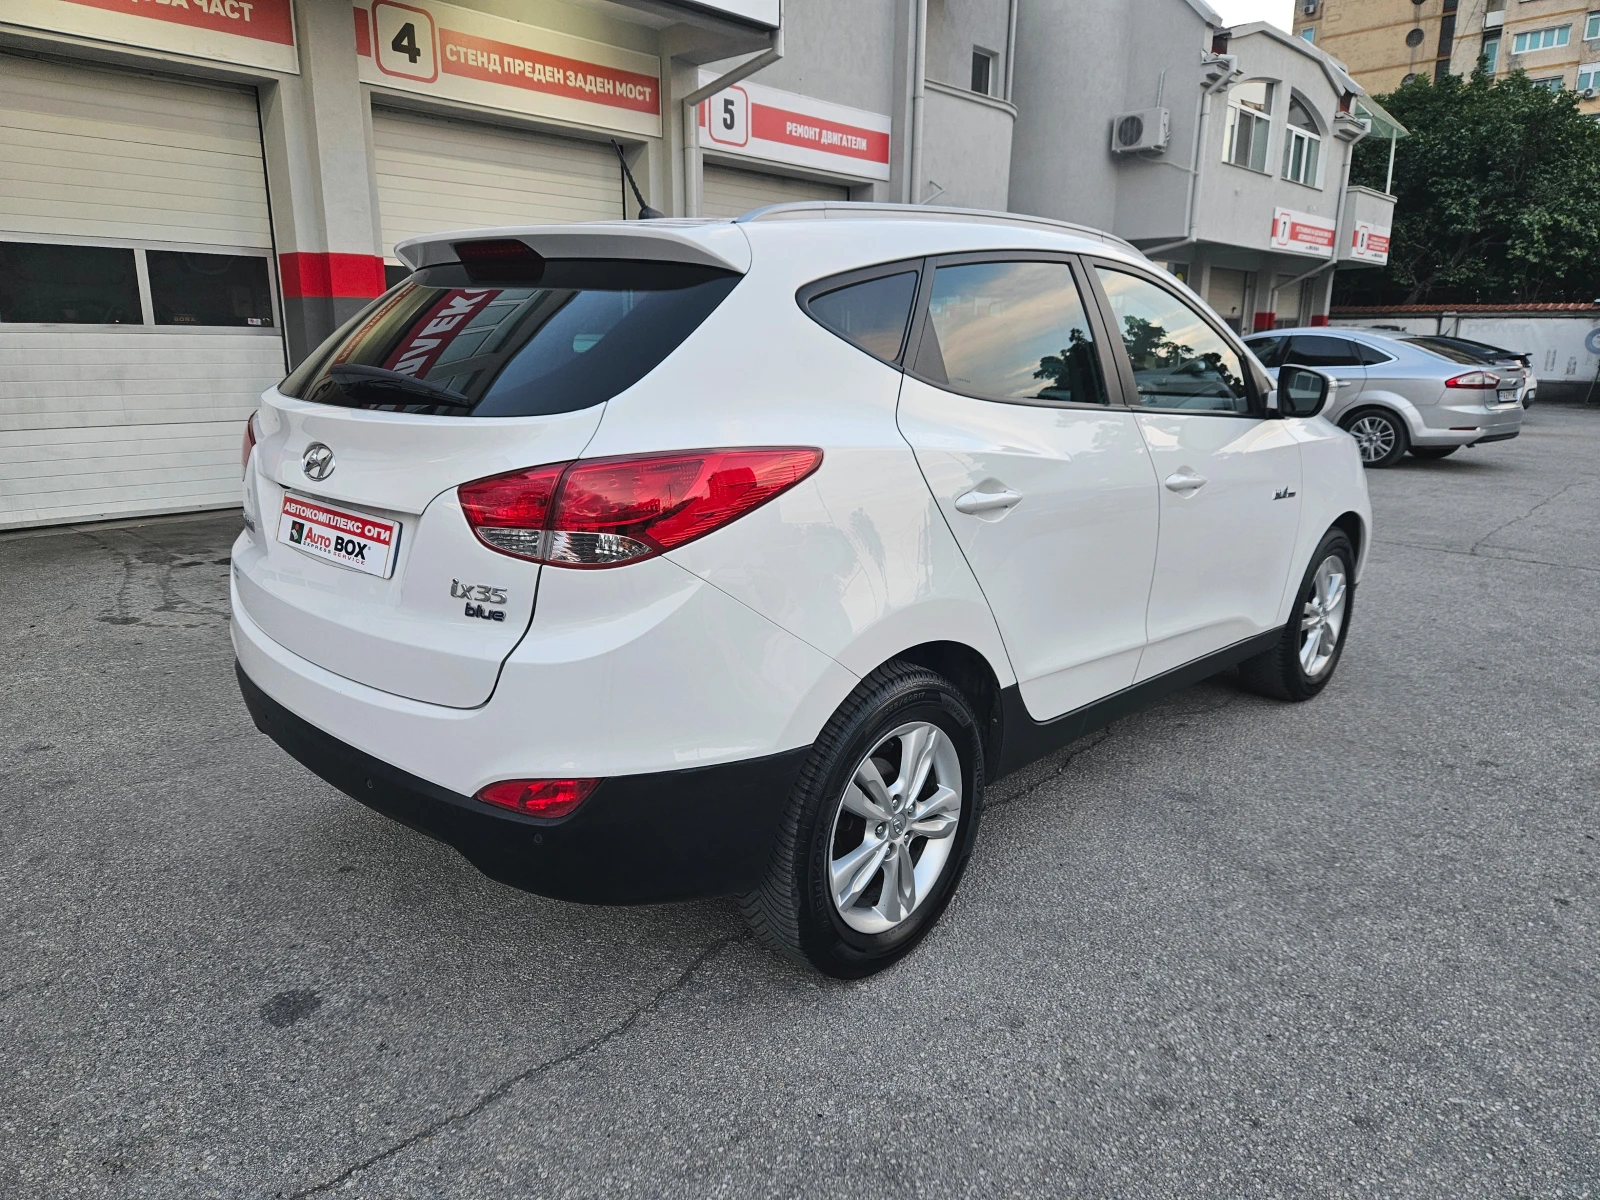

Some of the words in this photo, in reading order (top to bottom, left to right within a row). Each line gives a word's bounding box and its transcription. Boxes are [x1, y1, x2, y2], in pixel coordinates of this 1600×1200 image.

[192, 0, 253, 22] ЧАСТ
[391, 22, 421, 64] 4
[446, 43, 502, 75] СТЕНД
[503, 56, 564, 85] ПРЕДЕН
[566, 70, 614, 95] ЗАДЕН
[615, 82, 652, 102] МОСТ
[723, 98, 735, 131] 5
[786, 121, 820, 141] РЕМОНТ
[820, 129, 867, 151] ДВИГАТЕЛИ
[284, 501, 363, 533] АВТОКОМПЛЕКС
[364, 525, 391, 542] ОГИ
[302, 541, 331, 554] EXPRESS
[333, 551, 365, 566] SERVICE
[333, 535, 368, 560] BOX
[450, 578, 508, 605] ix35
[464, 602, 507, 622] blue
